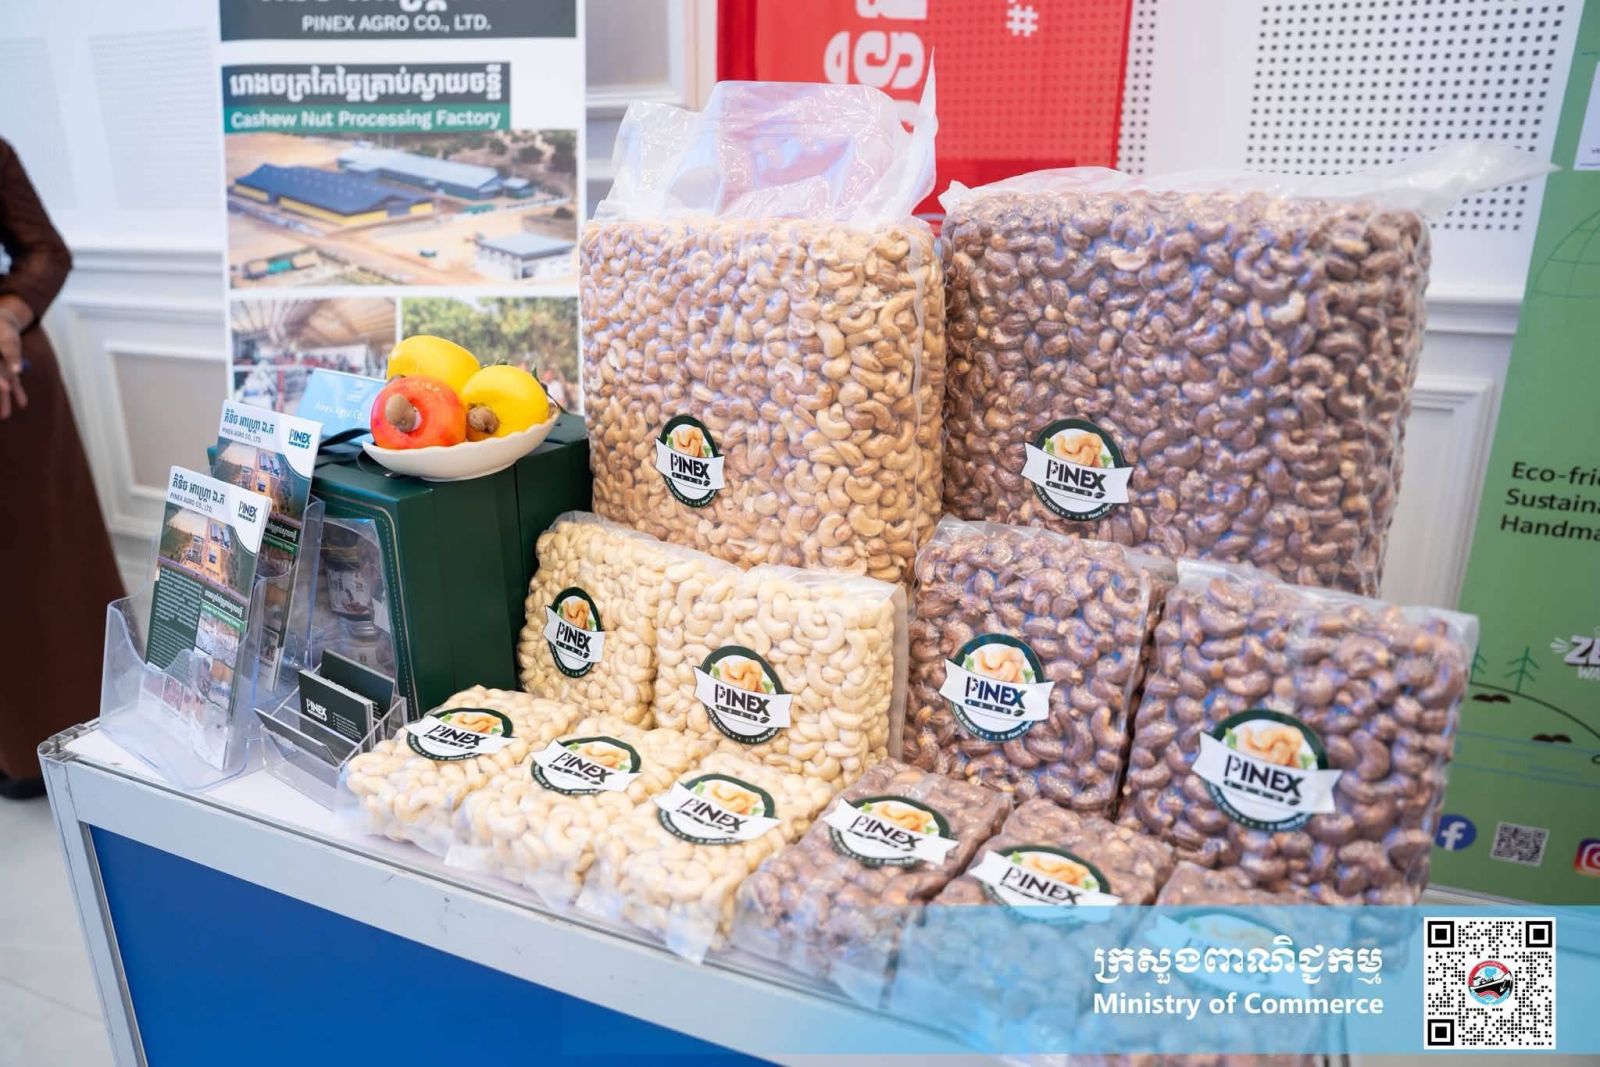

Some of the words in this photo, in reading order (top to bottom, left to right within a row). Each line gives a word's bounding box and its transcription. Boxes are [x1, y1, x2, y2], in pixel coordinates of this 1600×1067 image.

[302, 15, 355, 31] PINEX
[358, 14, 409, 31] AGRO
[413, 14, 450, 33] CO.,
[454, 14, 492, 31] LTD.
[231, 109, 298, 128] Cashew
[301, 111, 335, 127] Nut
[338, 109, 432, 130] Processing
[436, 109, 501, 130] Factory
[289, 428, 312, 445] PINEX
[670, 452, 711, 480] PINEX
[1046, 459, 1107, 492] PINEX
[1511, 461, 1600, 486] Eco-fri
[1505, 488, 1600, 514] Sustain
[556, 621, 592, 653] PINEX
[715, 684, 771, 717] PINEX
[965, 676, 1028, 709] PINEX
[427, 724, 488, 746] PINEX
[552, 752, 614, 783] PINEX
[1224, 754, 1304, 798] PINEX
[680, 798, 749, 831] PINEX
[850, 815, 922, 848] PINEX
[1002, 867, 1082, 904] PINEX
